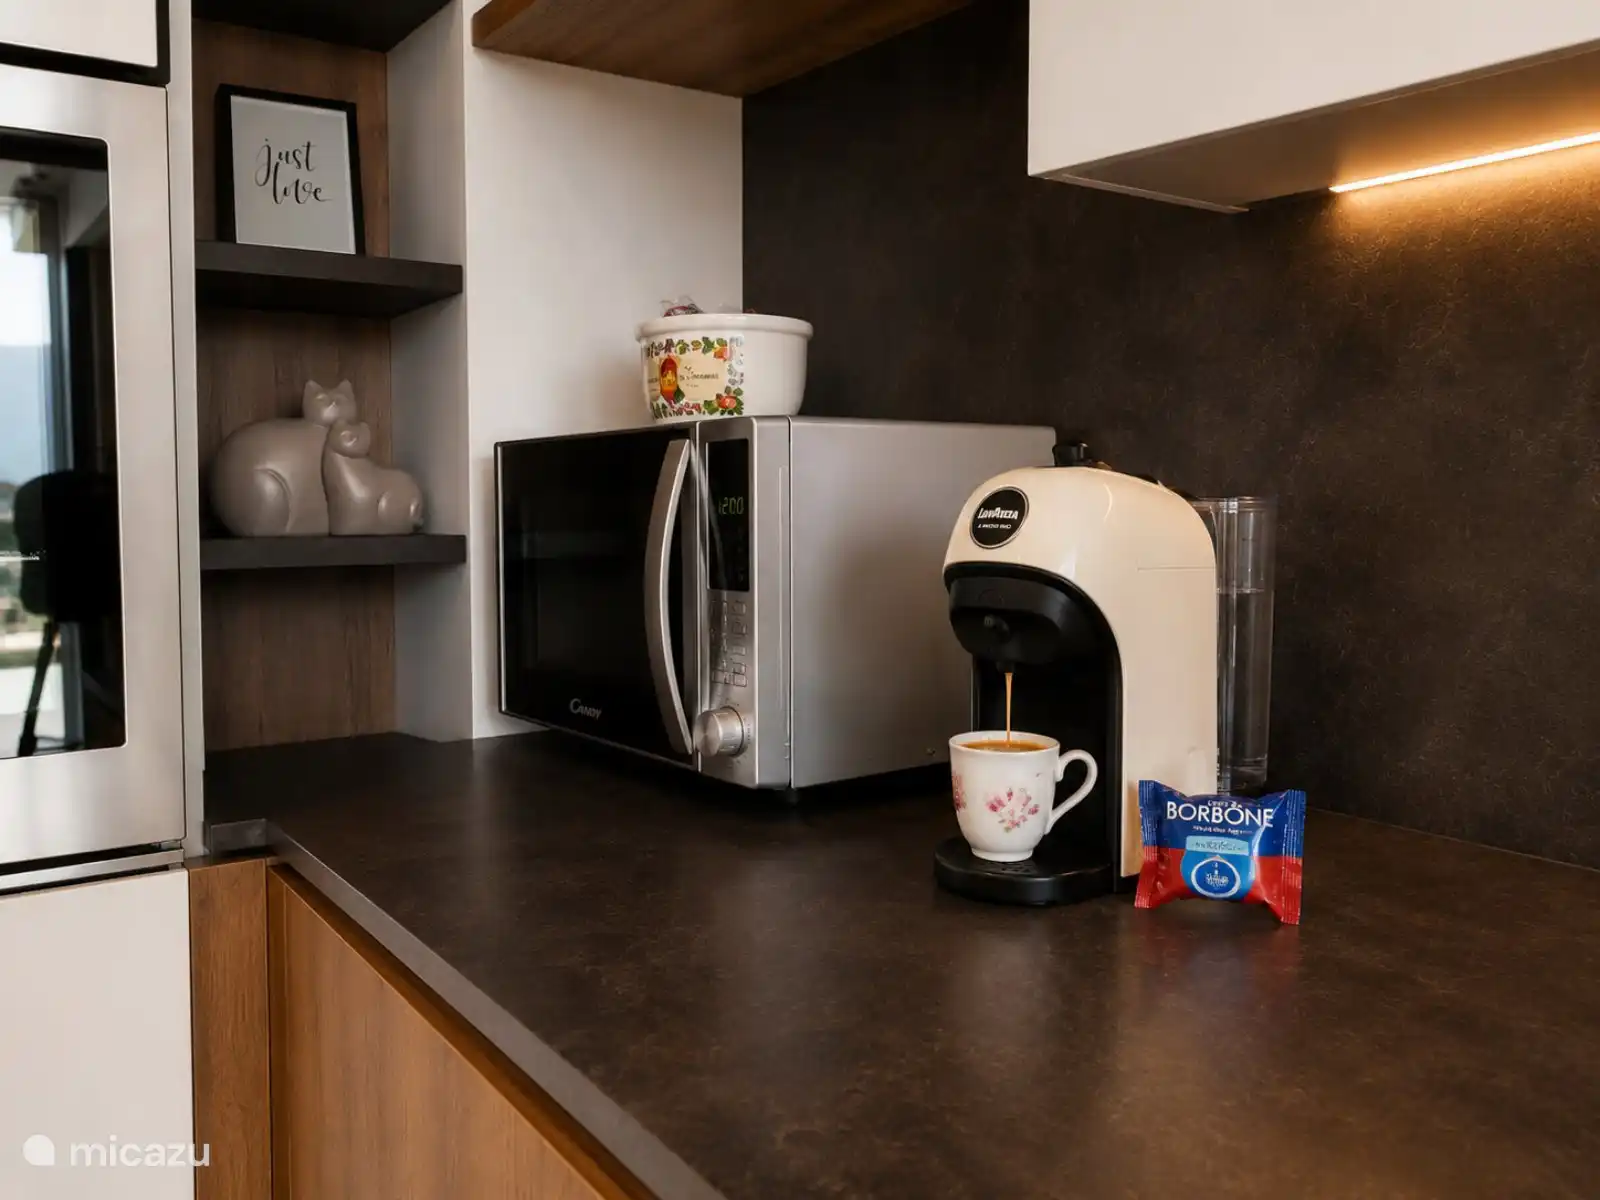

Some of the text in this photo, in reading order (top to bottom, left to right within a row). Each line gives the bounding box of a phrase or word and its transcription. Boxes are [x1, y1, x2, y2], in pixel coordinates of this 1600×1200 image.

[255, 138, 317, 187] just
[272, 161, 333, 205] love
[1166, 801, 1274, 828] BORBONE
